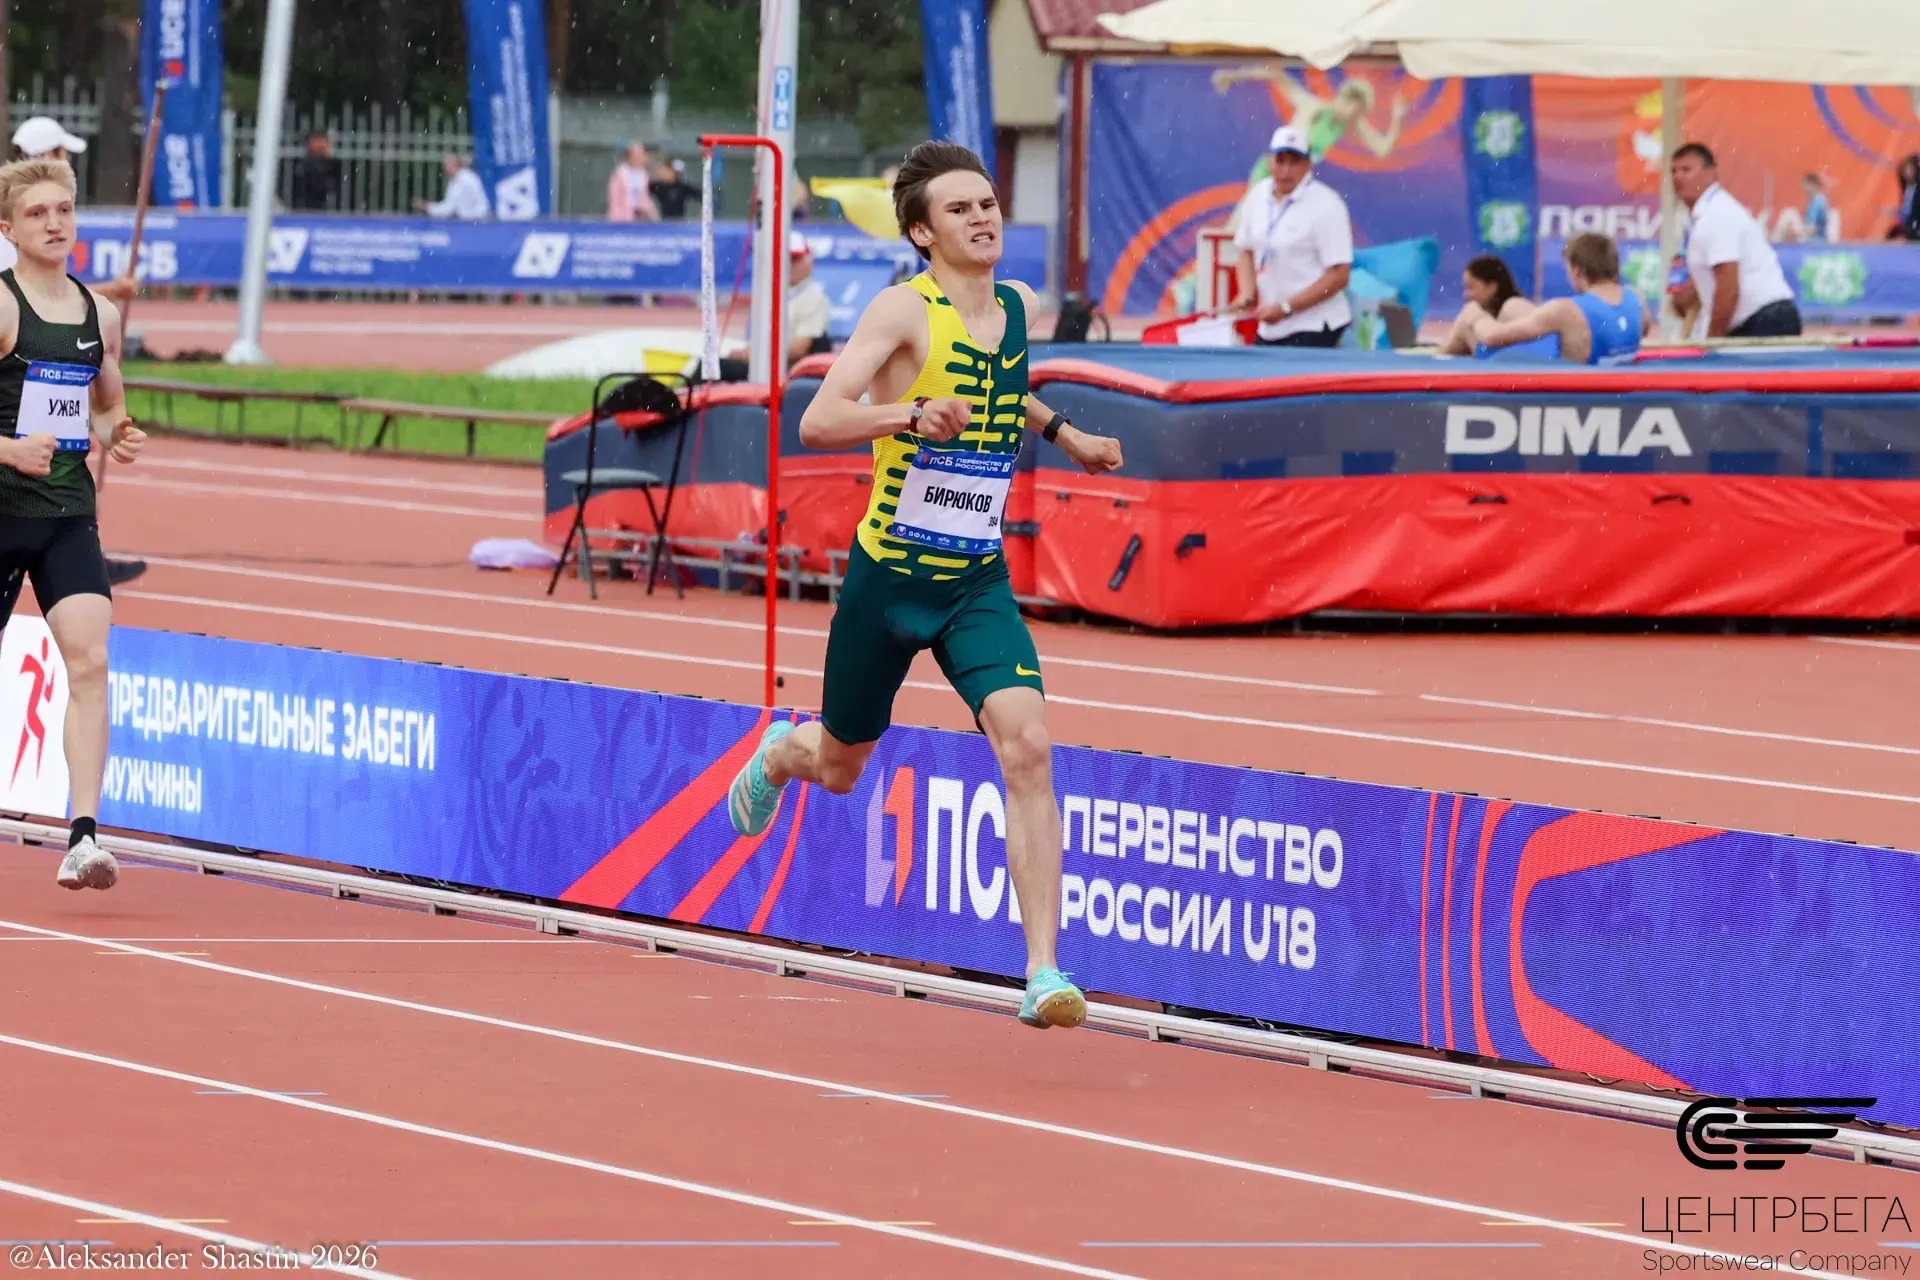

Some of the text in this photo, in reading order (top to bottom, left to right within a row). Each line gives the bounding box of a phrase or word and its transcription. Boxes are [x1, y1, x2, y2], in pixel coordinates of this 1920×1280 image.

[40, 368, 61, 380] ПСБ
[48, 398, 80, 417] УЖВА
[1445, 405, 1693, 456] DIMA
[929, 456, 953, 467] ПСБ
[924, 486, 992, 513] БИРЮКОВ
[908, 530, 931, 541] ВФЛА
[108, 671, 436, 770] ПРЕДВАРИТЕЛЬНЫЕ ЗАБЕГИ
[1063, 794, 1344, 890] ПЕРВЕНСТВО
[1061, 874, 1317, 970] РОССИИ U18
